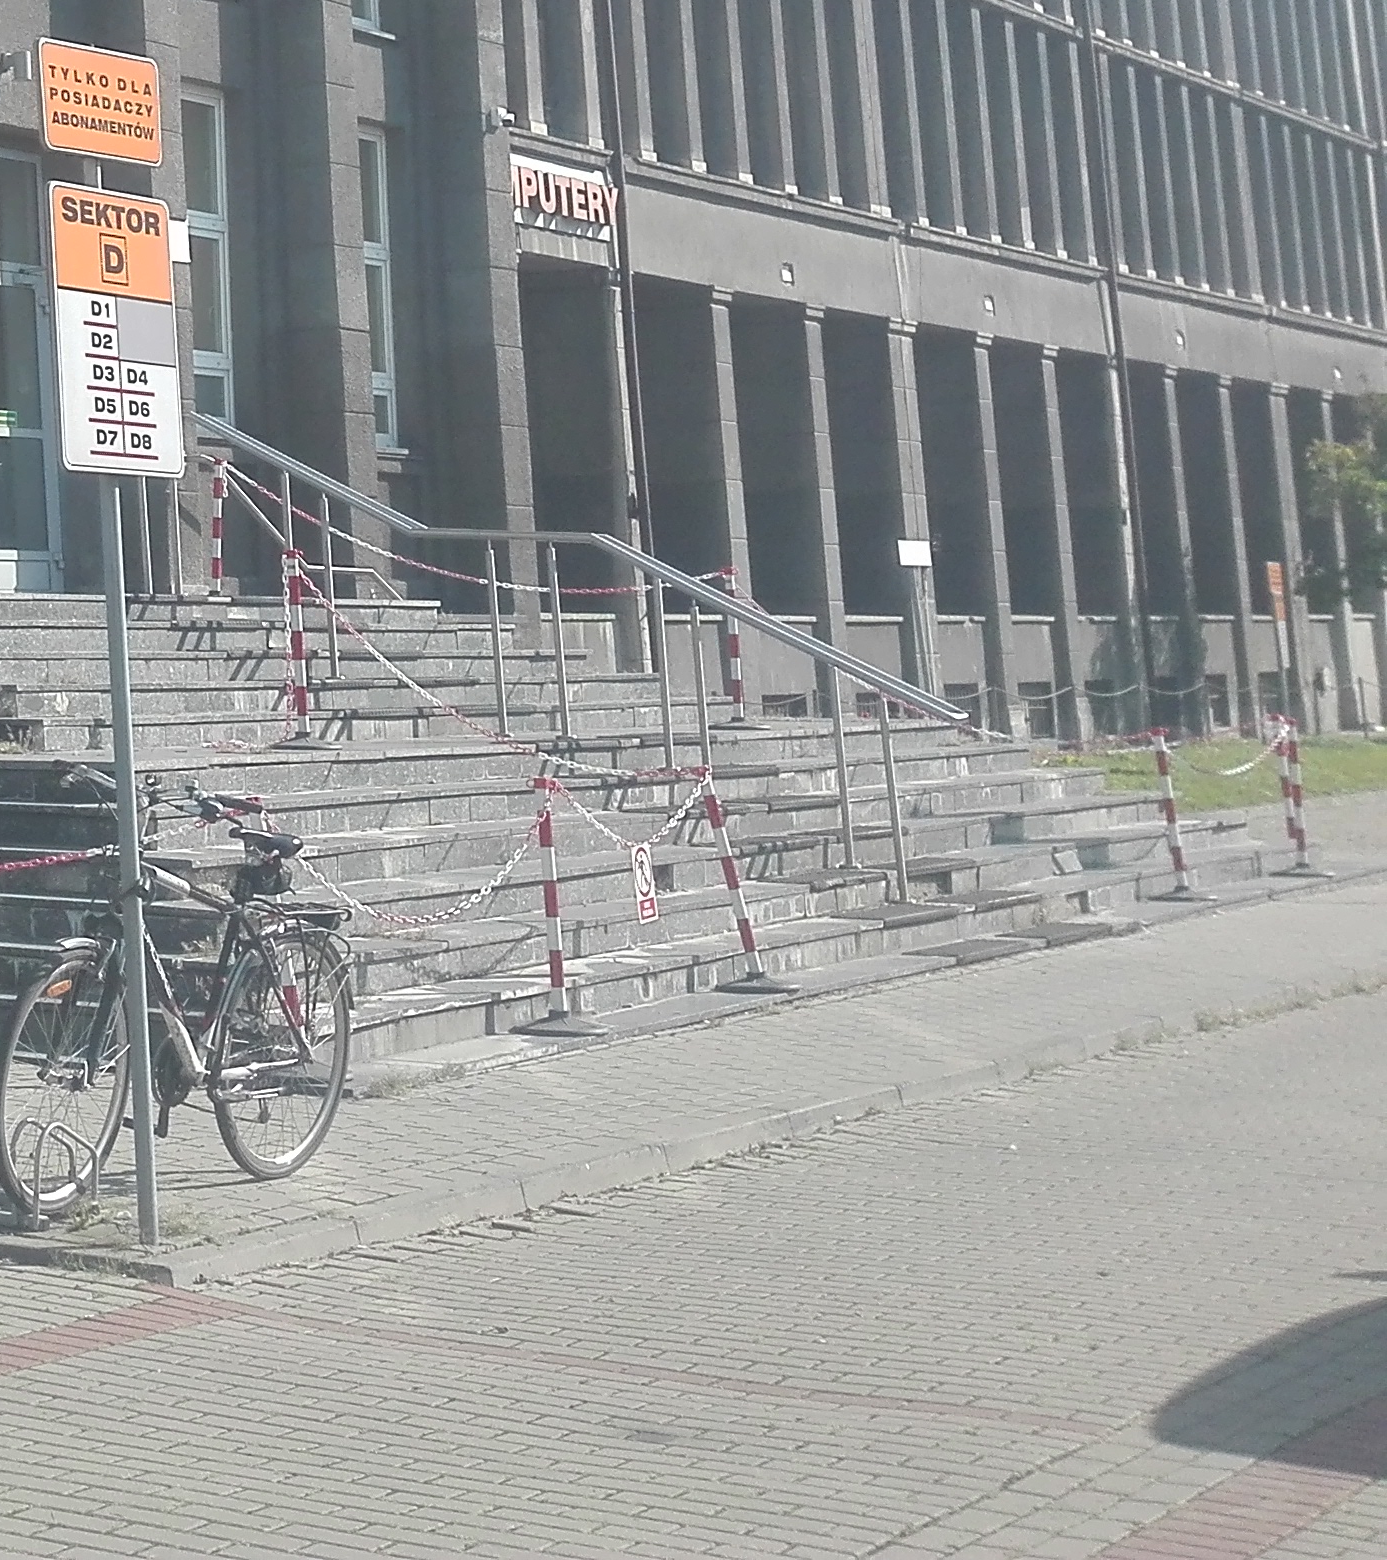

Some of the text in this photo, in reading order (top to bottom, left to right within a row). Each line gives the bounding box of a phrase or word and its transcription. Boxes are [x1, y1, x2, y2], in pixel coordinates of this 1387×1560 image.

[48, 64, 152, 96] TYLKO DLA
[49, 87, 153, 117] POSIADACZY
[51, 111, 155, 140] ABONAMENTÓW
[61, 196, 161, 237] SEKTOR
[103, 243, 124, 274] D
[91, 300, 110, 318] D1
[91, 332, 113, 350] D2
[93, 364, 149, 386] D3 D4
[94, 396, 150, 417] D5 D6
[96, 429, 152, 450] D7 D8
